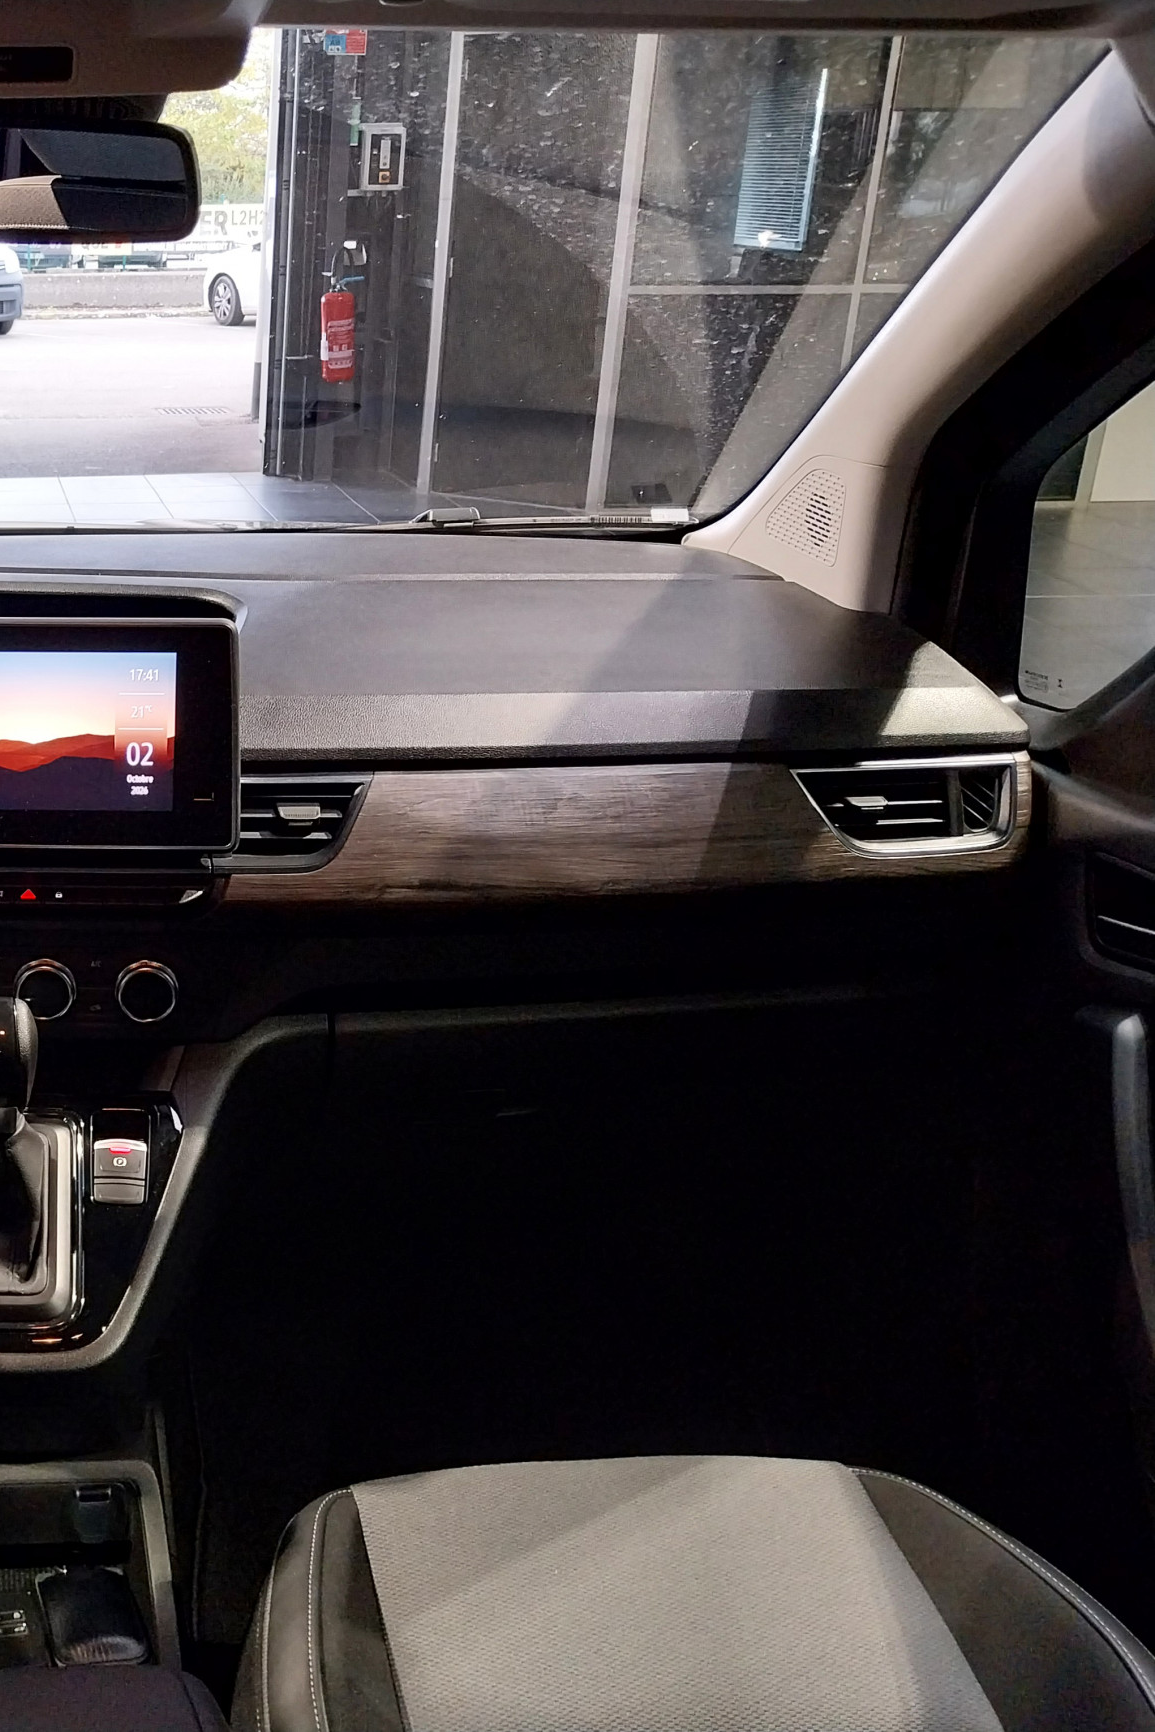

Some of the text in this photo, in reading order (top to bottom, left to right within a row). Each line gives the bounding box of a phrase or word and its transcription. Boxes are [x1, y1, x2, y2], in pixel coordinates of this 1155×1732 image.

[200, 210, 228, 236] ER
[129, 668, 159, 681] 17:41
[126, 741, 154, 767] 02
[126, 774, 154, 784] Octobre
